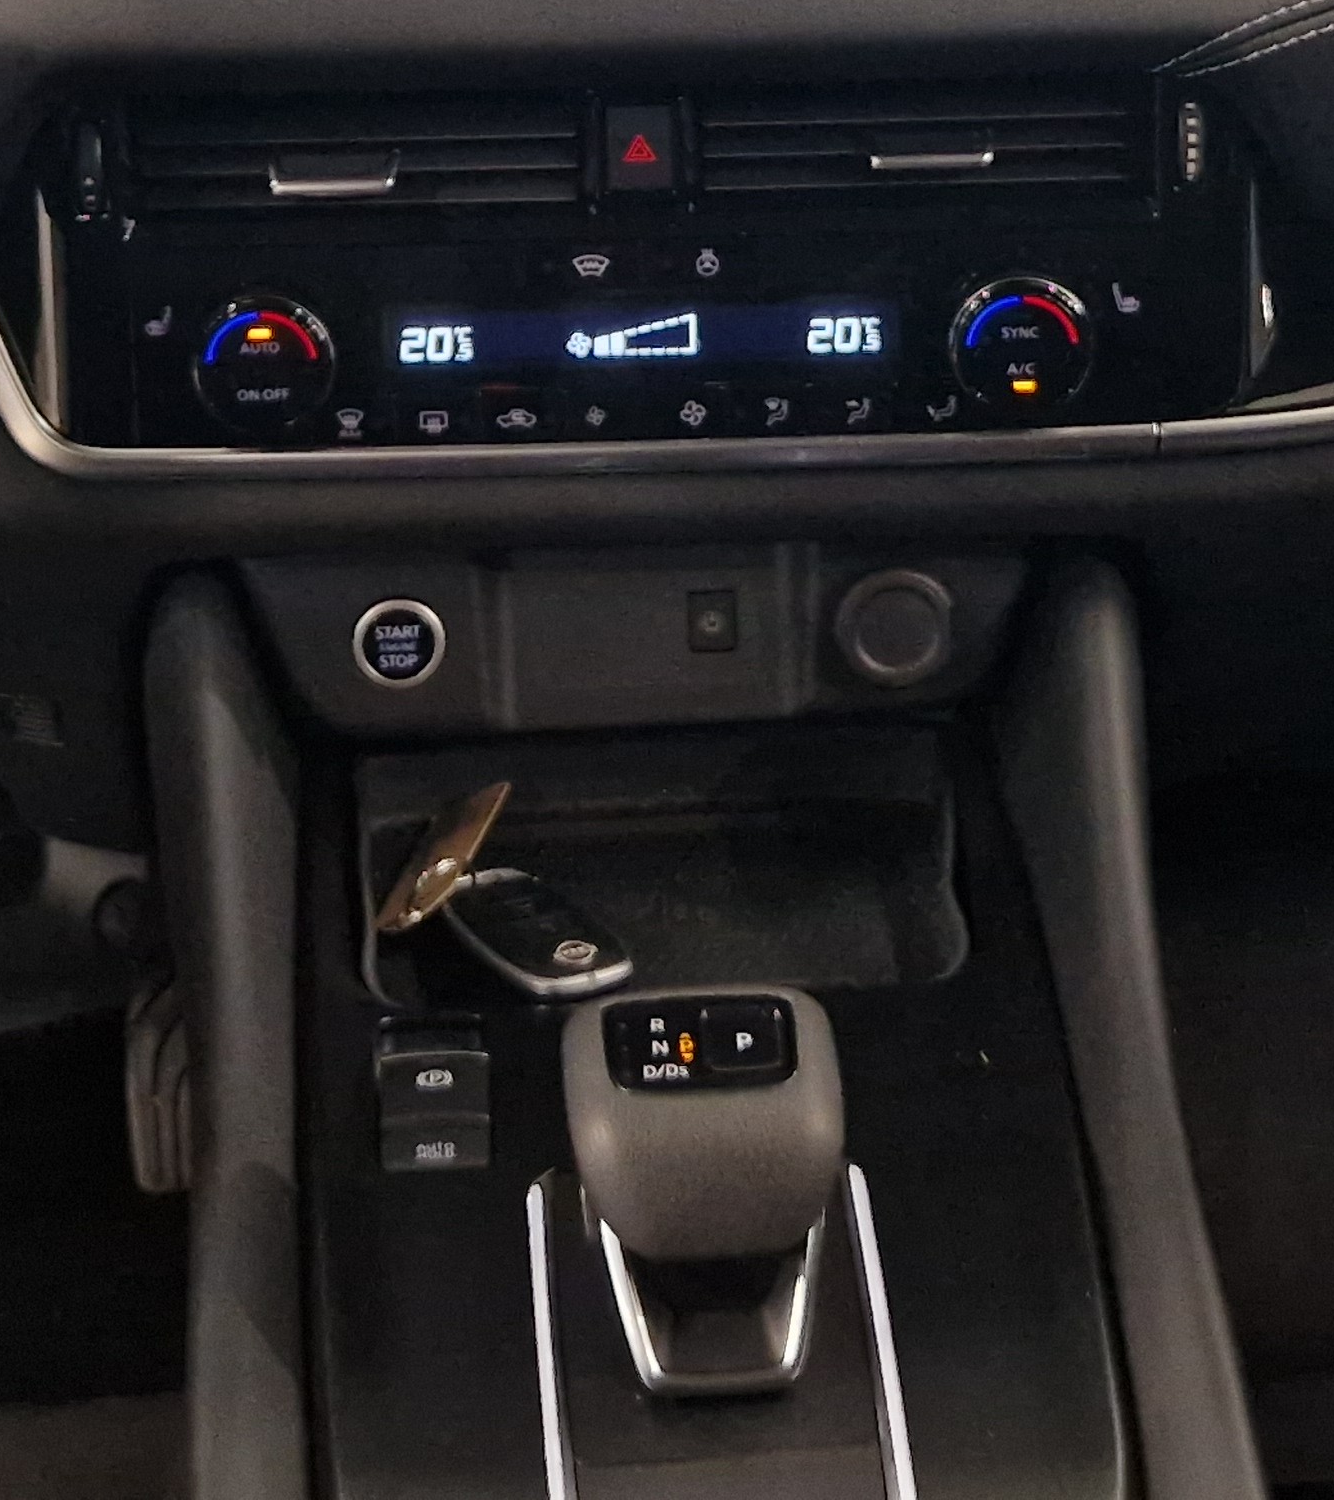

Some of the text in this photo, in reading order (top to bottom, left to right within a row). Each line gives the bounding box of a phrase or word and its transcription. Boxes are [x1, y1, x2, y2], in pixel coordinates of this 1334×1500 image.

[1001, 327, 1040, 339] SYNC
[240, 341, 280, 355] AUTO
[1007, 363, 1035, 375] A/C
[375, 625, 420, 640] START
[379, 654, 419, 668] STOP
[650, 1018, 665, 1032] R
[652, 1040, 669, 1056] N
[736, 1032, 753, 1052] P
